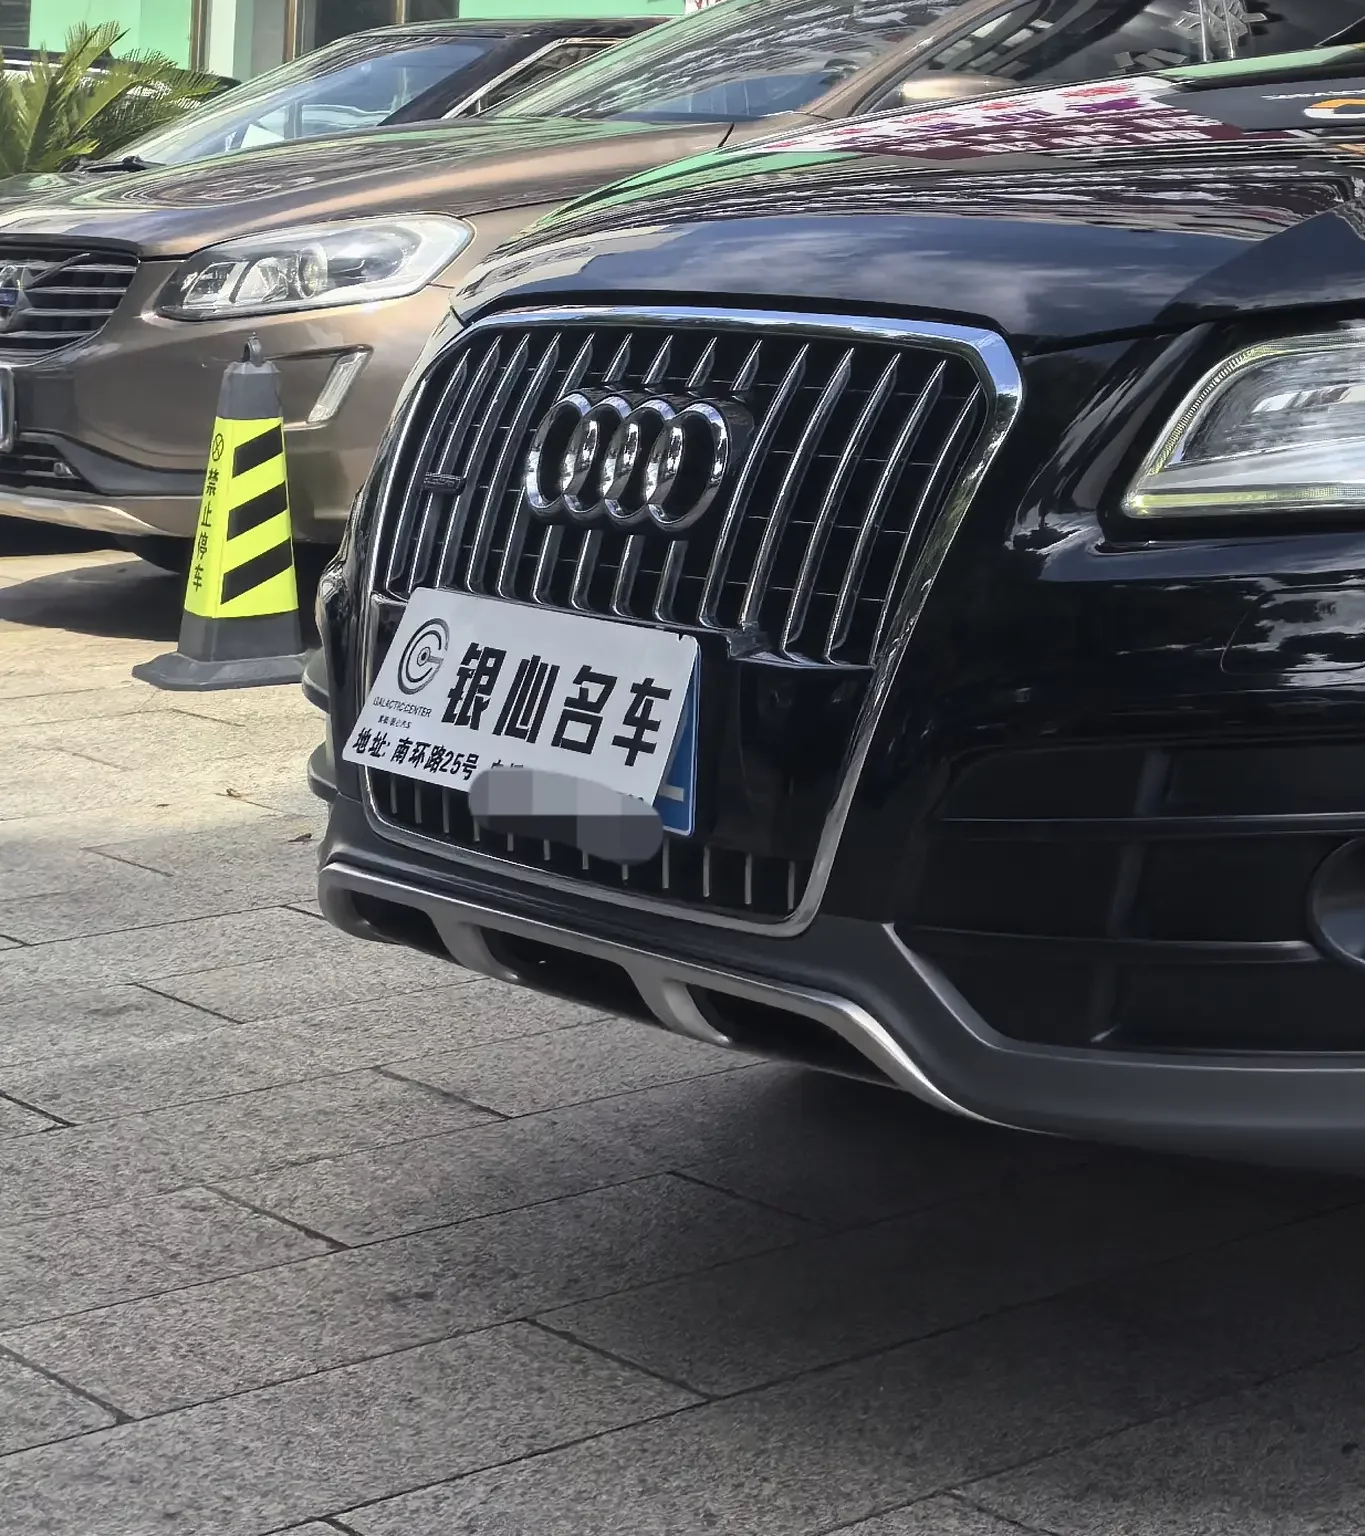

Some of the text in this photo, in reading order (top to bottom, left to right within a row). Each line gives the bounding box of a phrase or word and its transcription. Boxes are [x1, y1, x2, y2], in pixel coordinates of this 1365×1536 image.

[192, 468, 220, 592] 禁止停车
[441, 641, 672, 767] 银心名车
